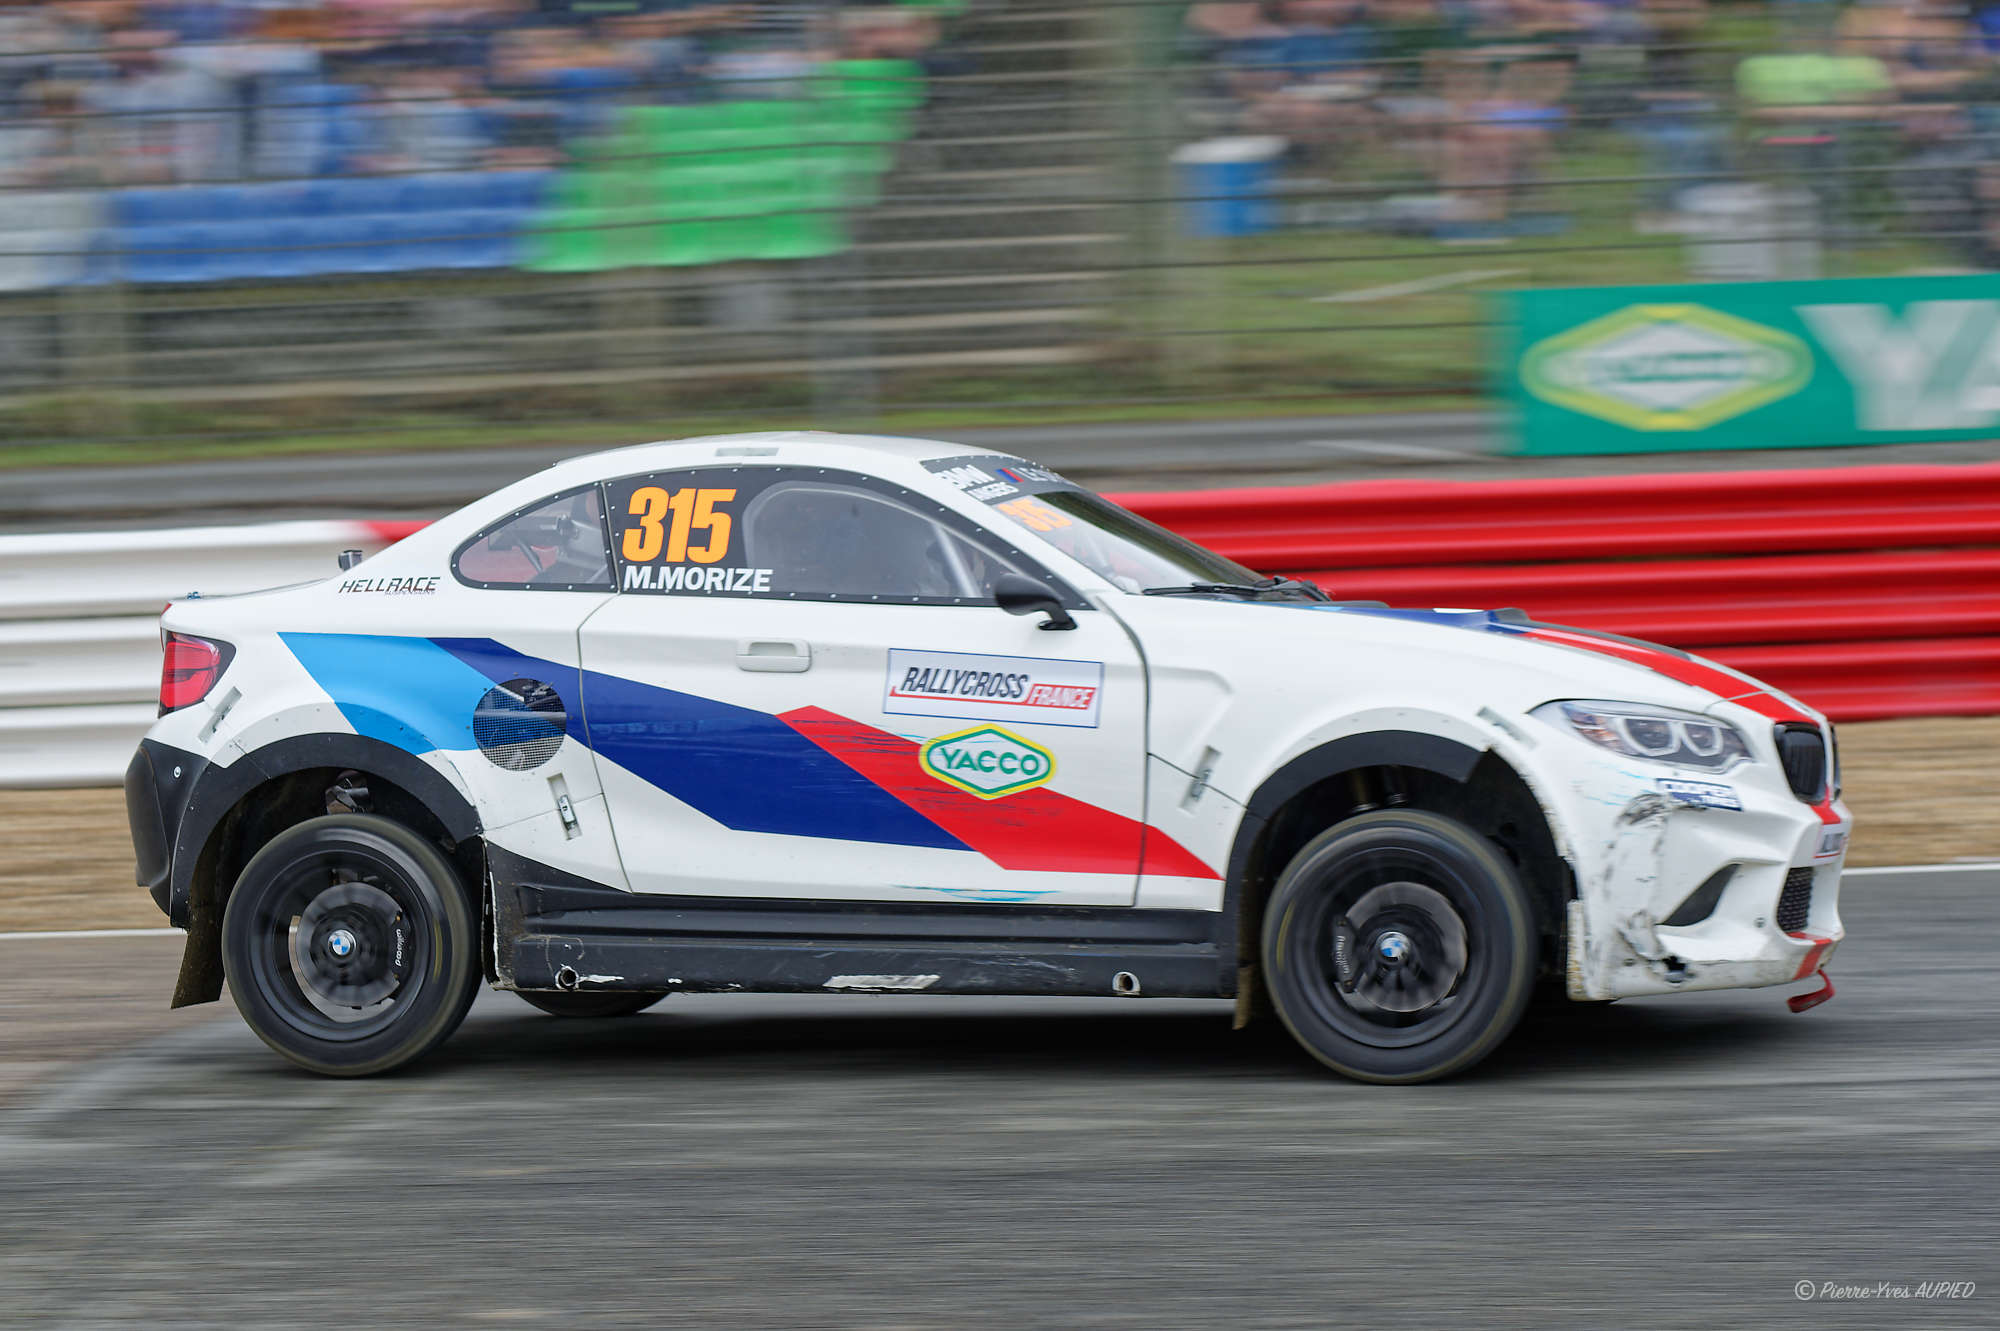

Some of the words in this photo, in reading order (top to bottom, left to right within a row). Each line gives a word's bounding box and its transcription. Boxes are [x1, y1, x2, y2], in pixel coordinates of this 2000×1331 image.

[622, 486, 737, 564] 315
[338, 577, 440, 593] HELLRACE
[624, 565, 773, 592] M.MORIZE
[901, 667, 1028, 698] RALLYCROSS
[1029, 685, 1093, 709] FRANCE
[940, 747, 1040, 775] YACCO
